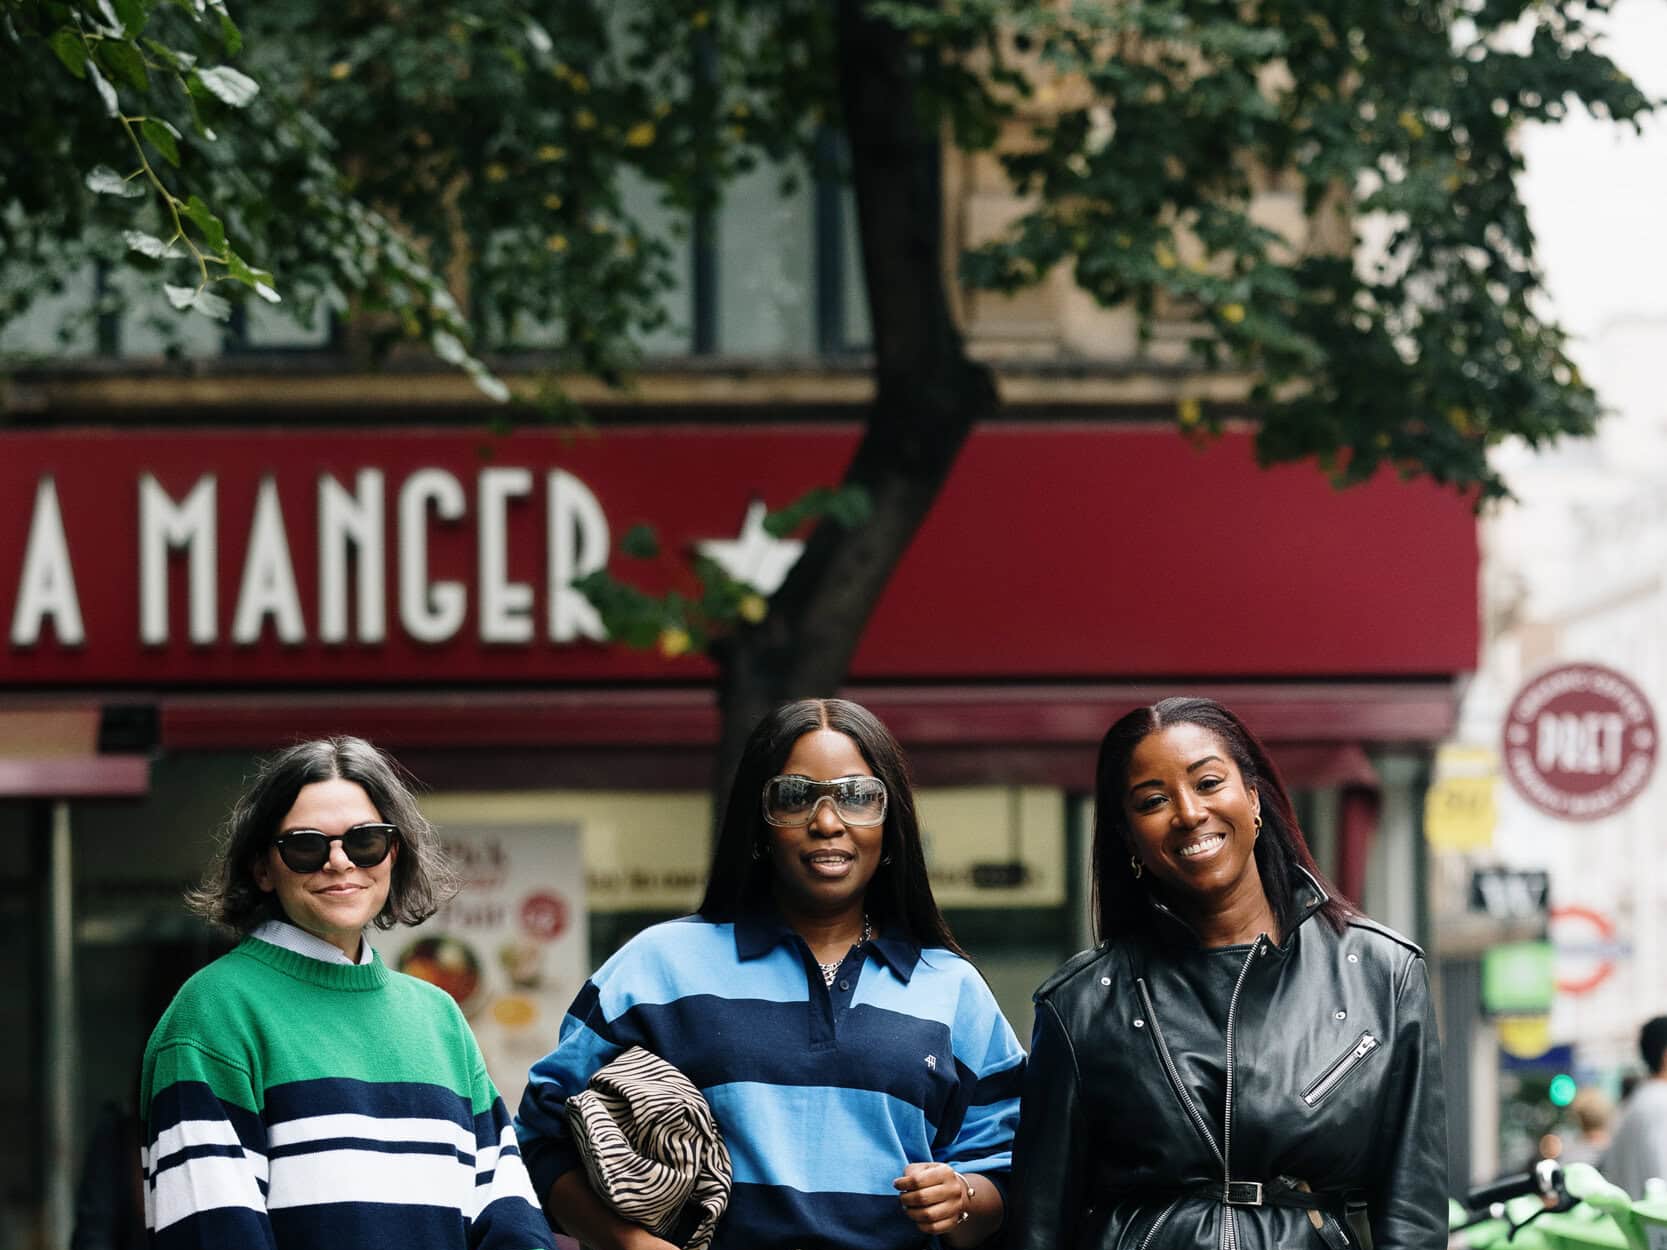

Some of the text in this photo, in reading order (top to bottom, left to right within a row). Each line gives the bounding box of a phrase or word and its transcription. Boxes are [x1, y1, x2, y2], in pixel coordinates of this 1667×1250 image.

[11, 467, 609, 645] A MANGER
[1537, 711, 1622, 773] PRET
